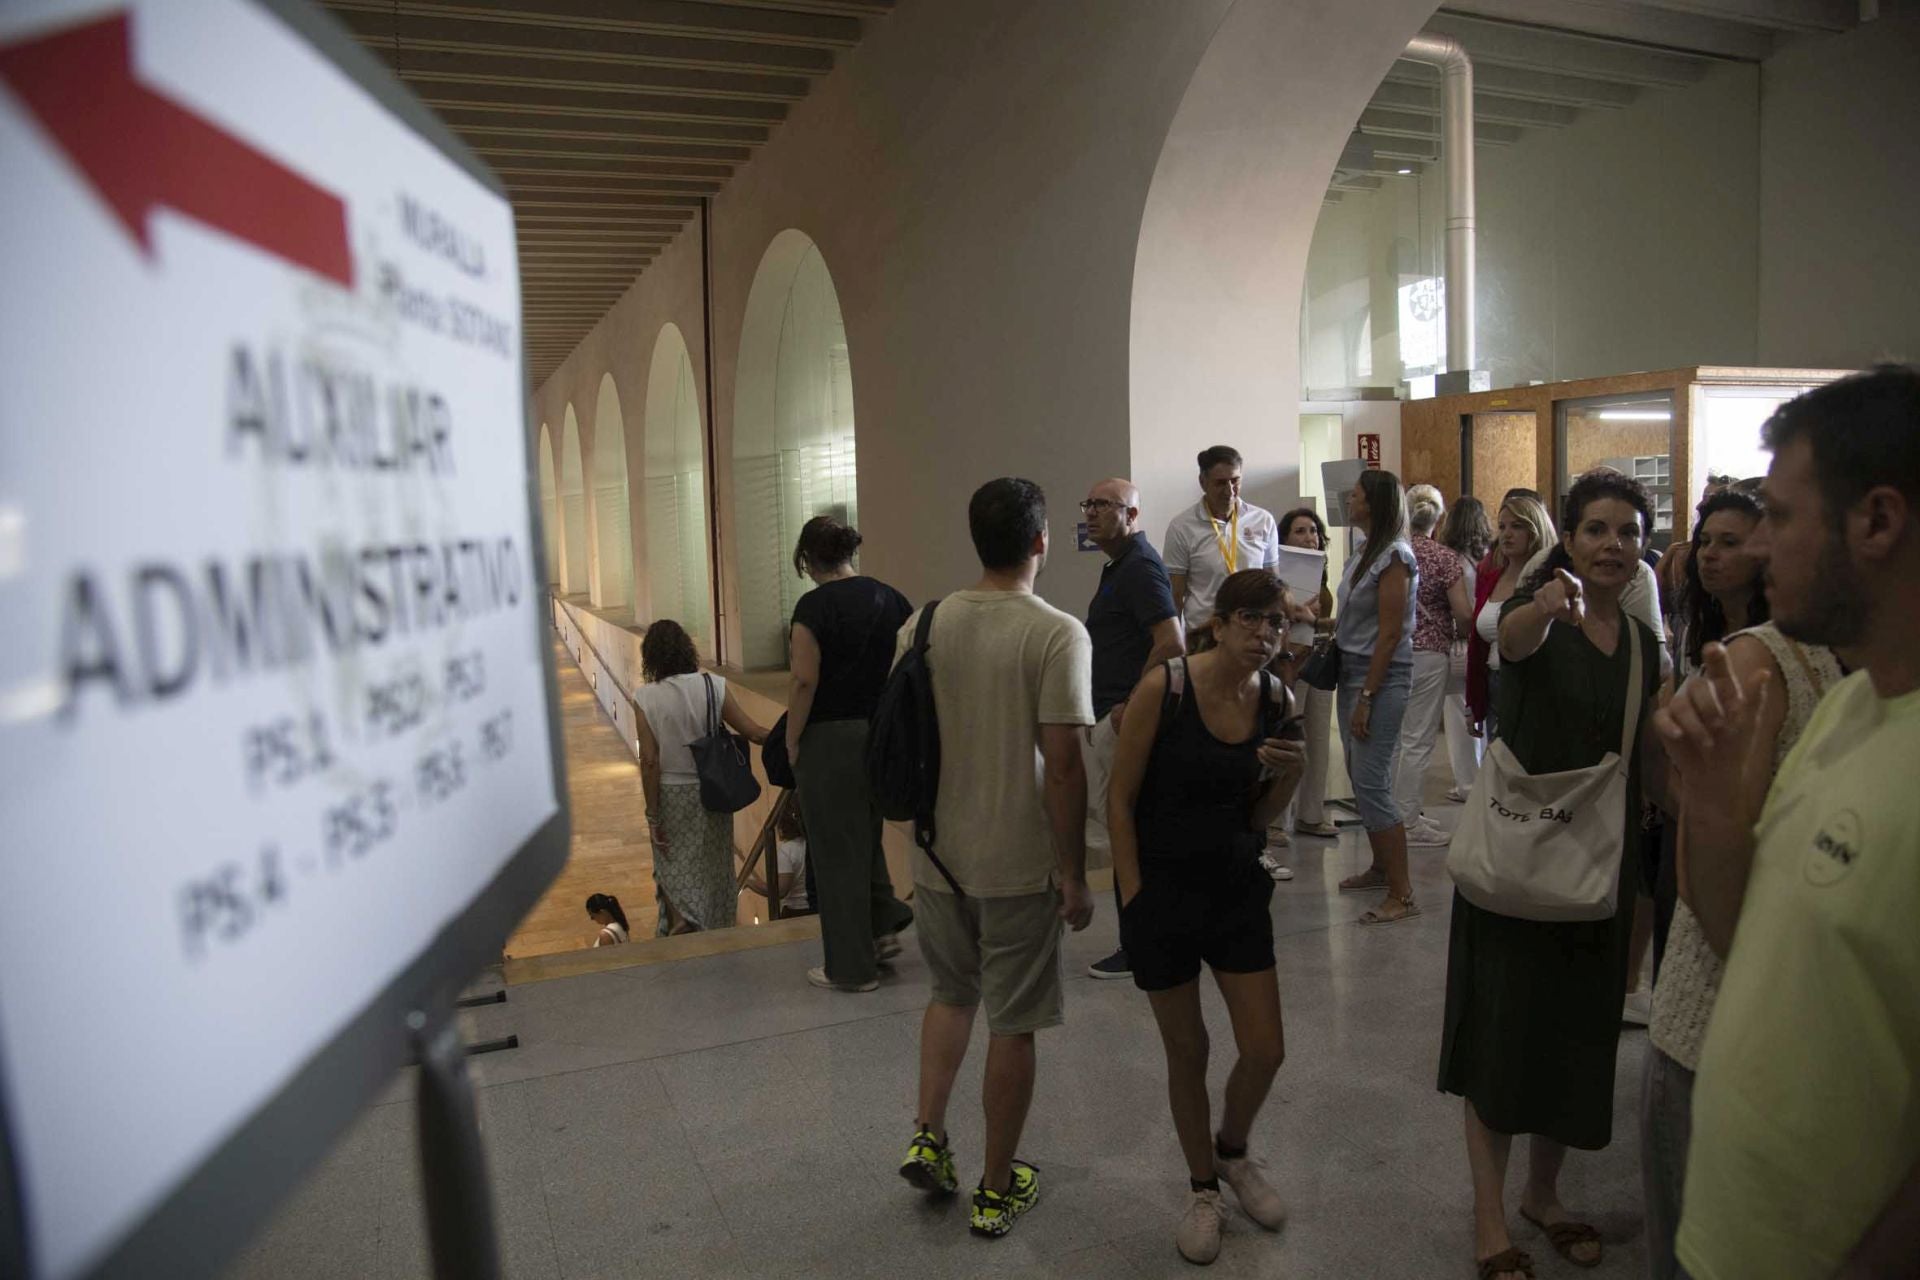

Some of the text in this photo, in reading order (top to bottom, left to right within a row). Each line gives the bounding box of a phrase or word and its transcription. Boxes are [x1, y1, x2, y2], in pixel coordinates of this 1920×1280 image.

[224, 340, 456, 478] AUXILIAR
[58, 536, 521, 726] ADMINISTRATIVO
[1489, 797, 1531, 822] TOTE
